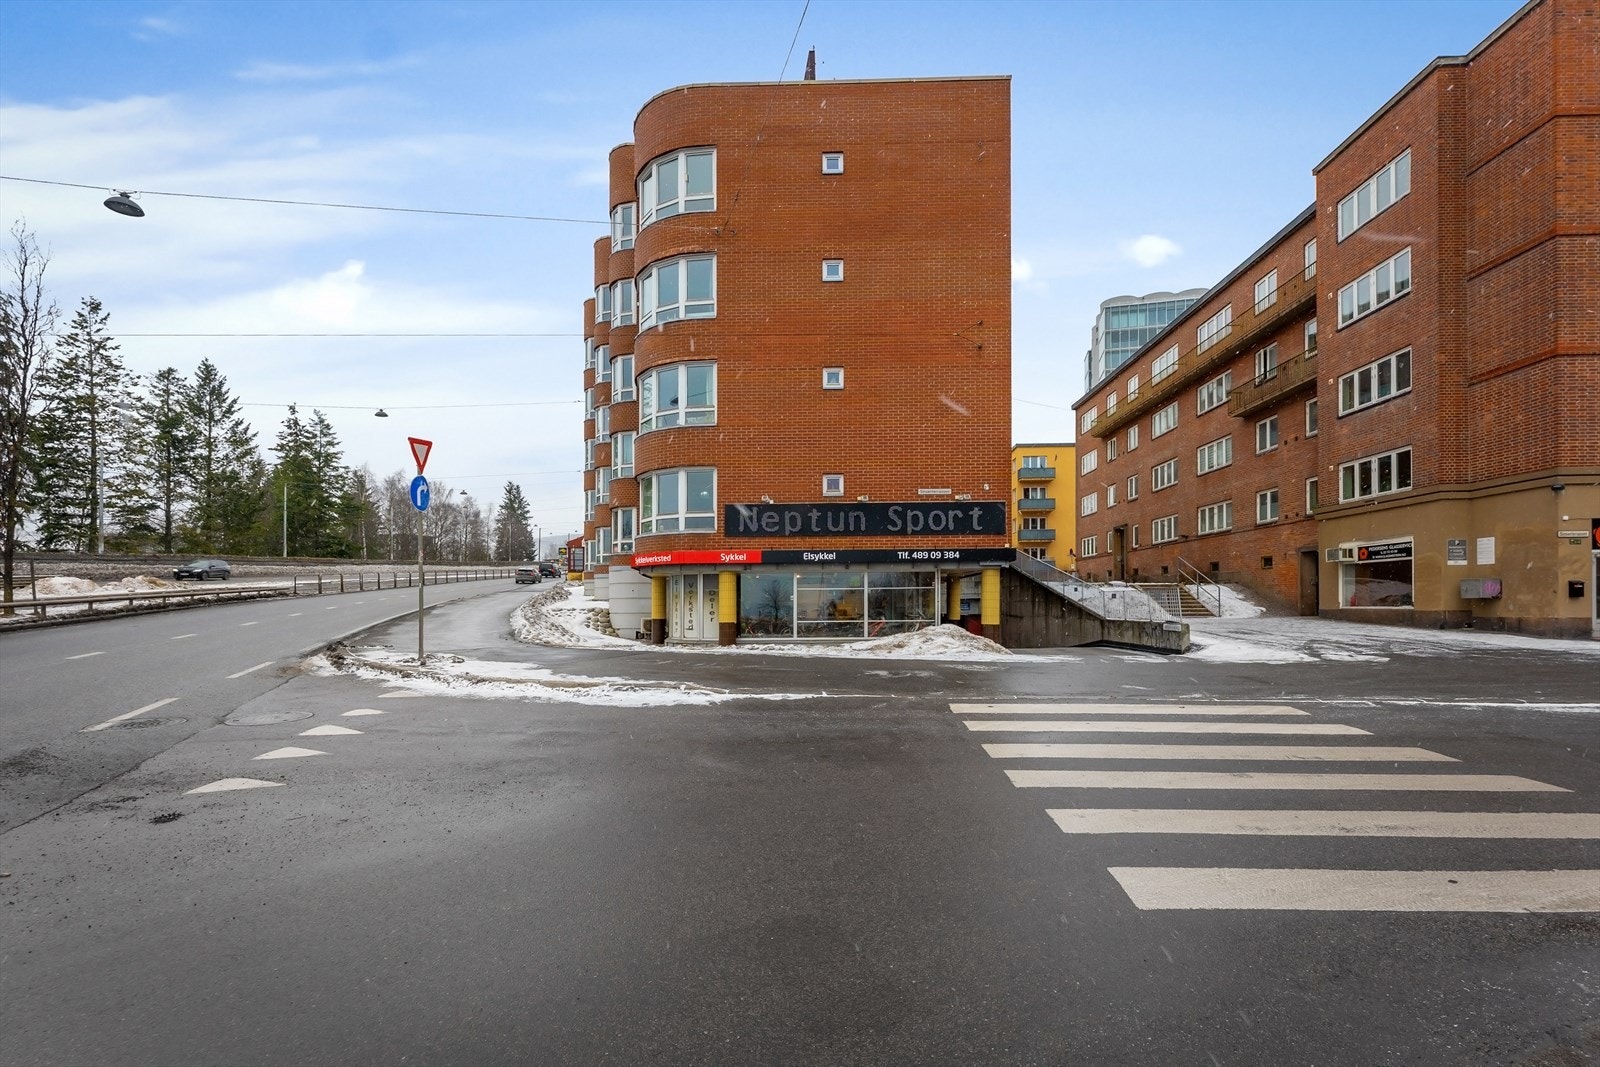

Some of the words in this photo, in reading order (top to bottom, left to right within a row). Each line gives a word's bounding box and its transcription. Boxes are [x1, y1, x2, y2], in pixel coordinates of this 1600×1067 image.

[738, 507, 866, 536] Neptun
[887, 505, 984, 535] Sport
[720, 552, 747, 562] Sykkel
[803, 551, 836, 561] Elsykkel
[897, 551, 911, 560] Tlf.
[911, 551, 928, 560] 489
[929, 551, 942, 559] 09
[943, 551, 960, 559] 384
